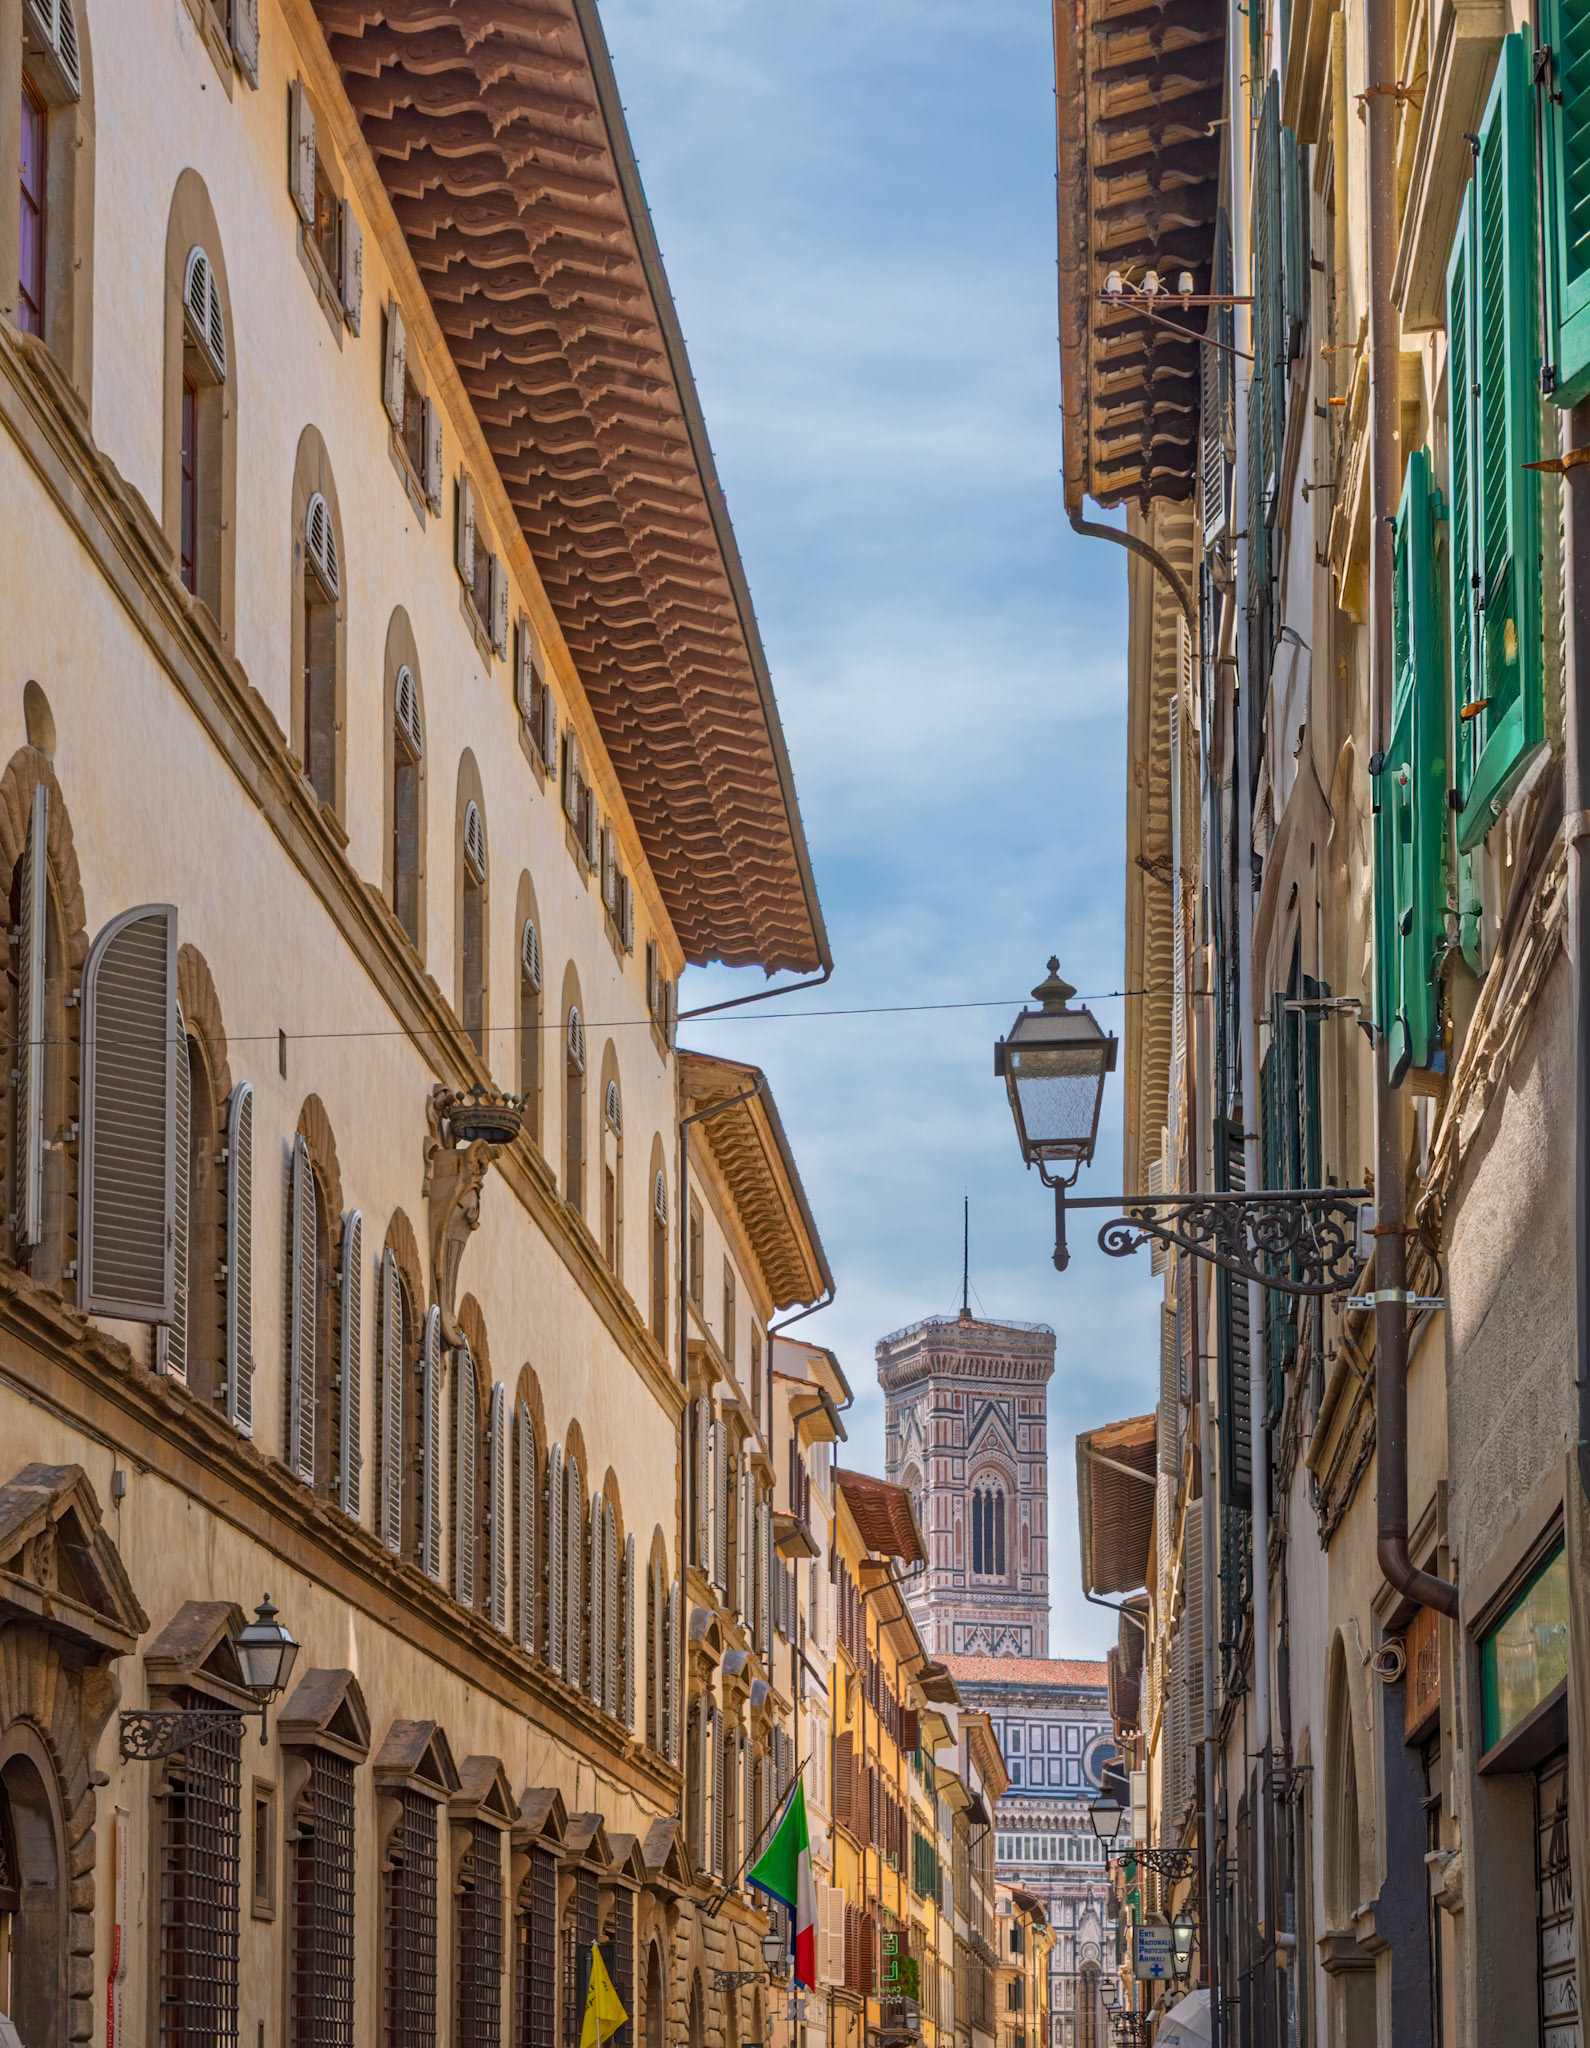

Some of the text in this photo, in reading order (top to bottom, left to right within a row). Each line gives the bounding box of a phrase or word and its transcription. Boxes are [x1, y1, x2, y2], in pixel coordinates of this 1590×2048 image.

[1139, 1929, 1155, 1937] ENTE
[1139, 1946, 1170, 1954] PROTEZIO
[1139, 1954, 1165, 1962] ANIMALI
